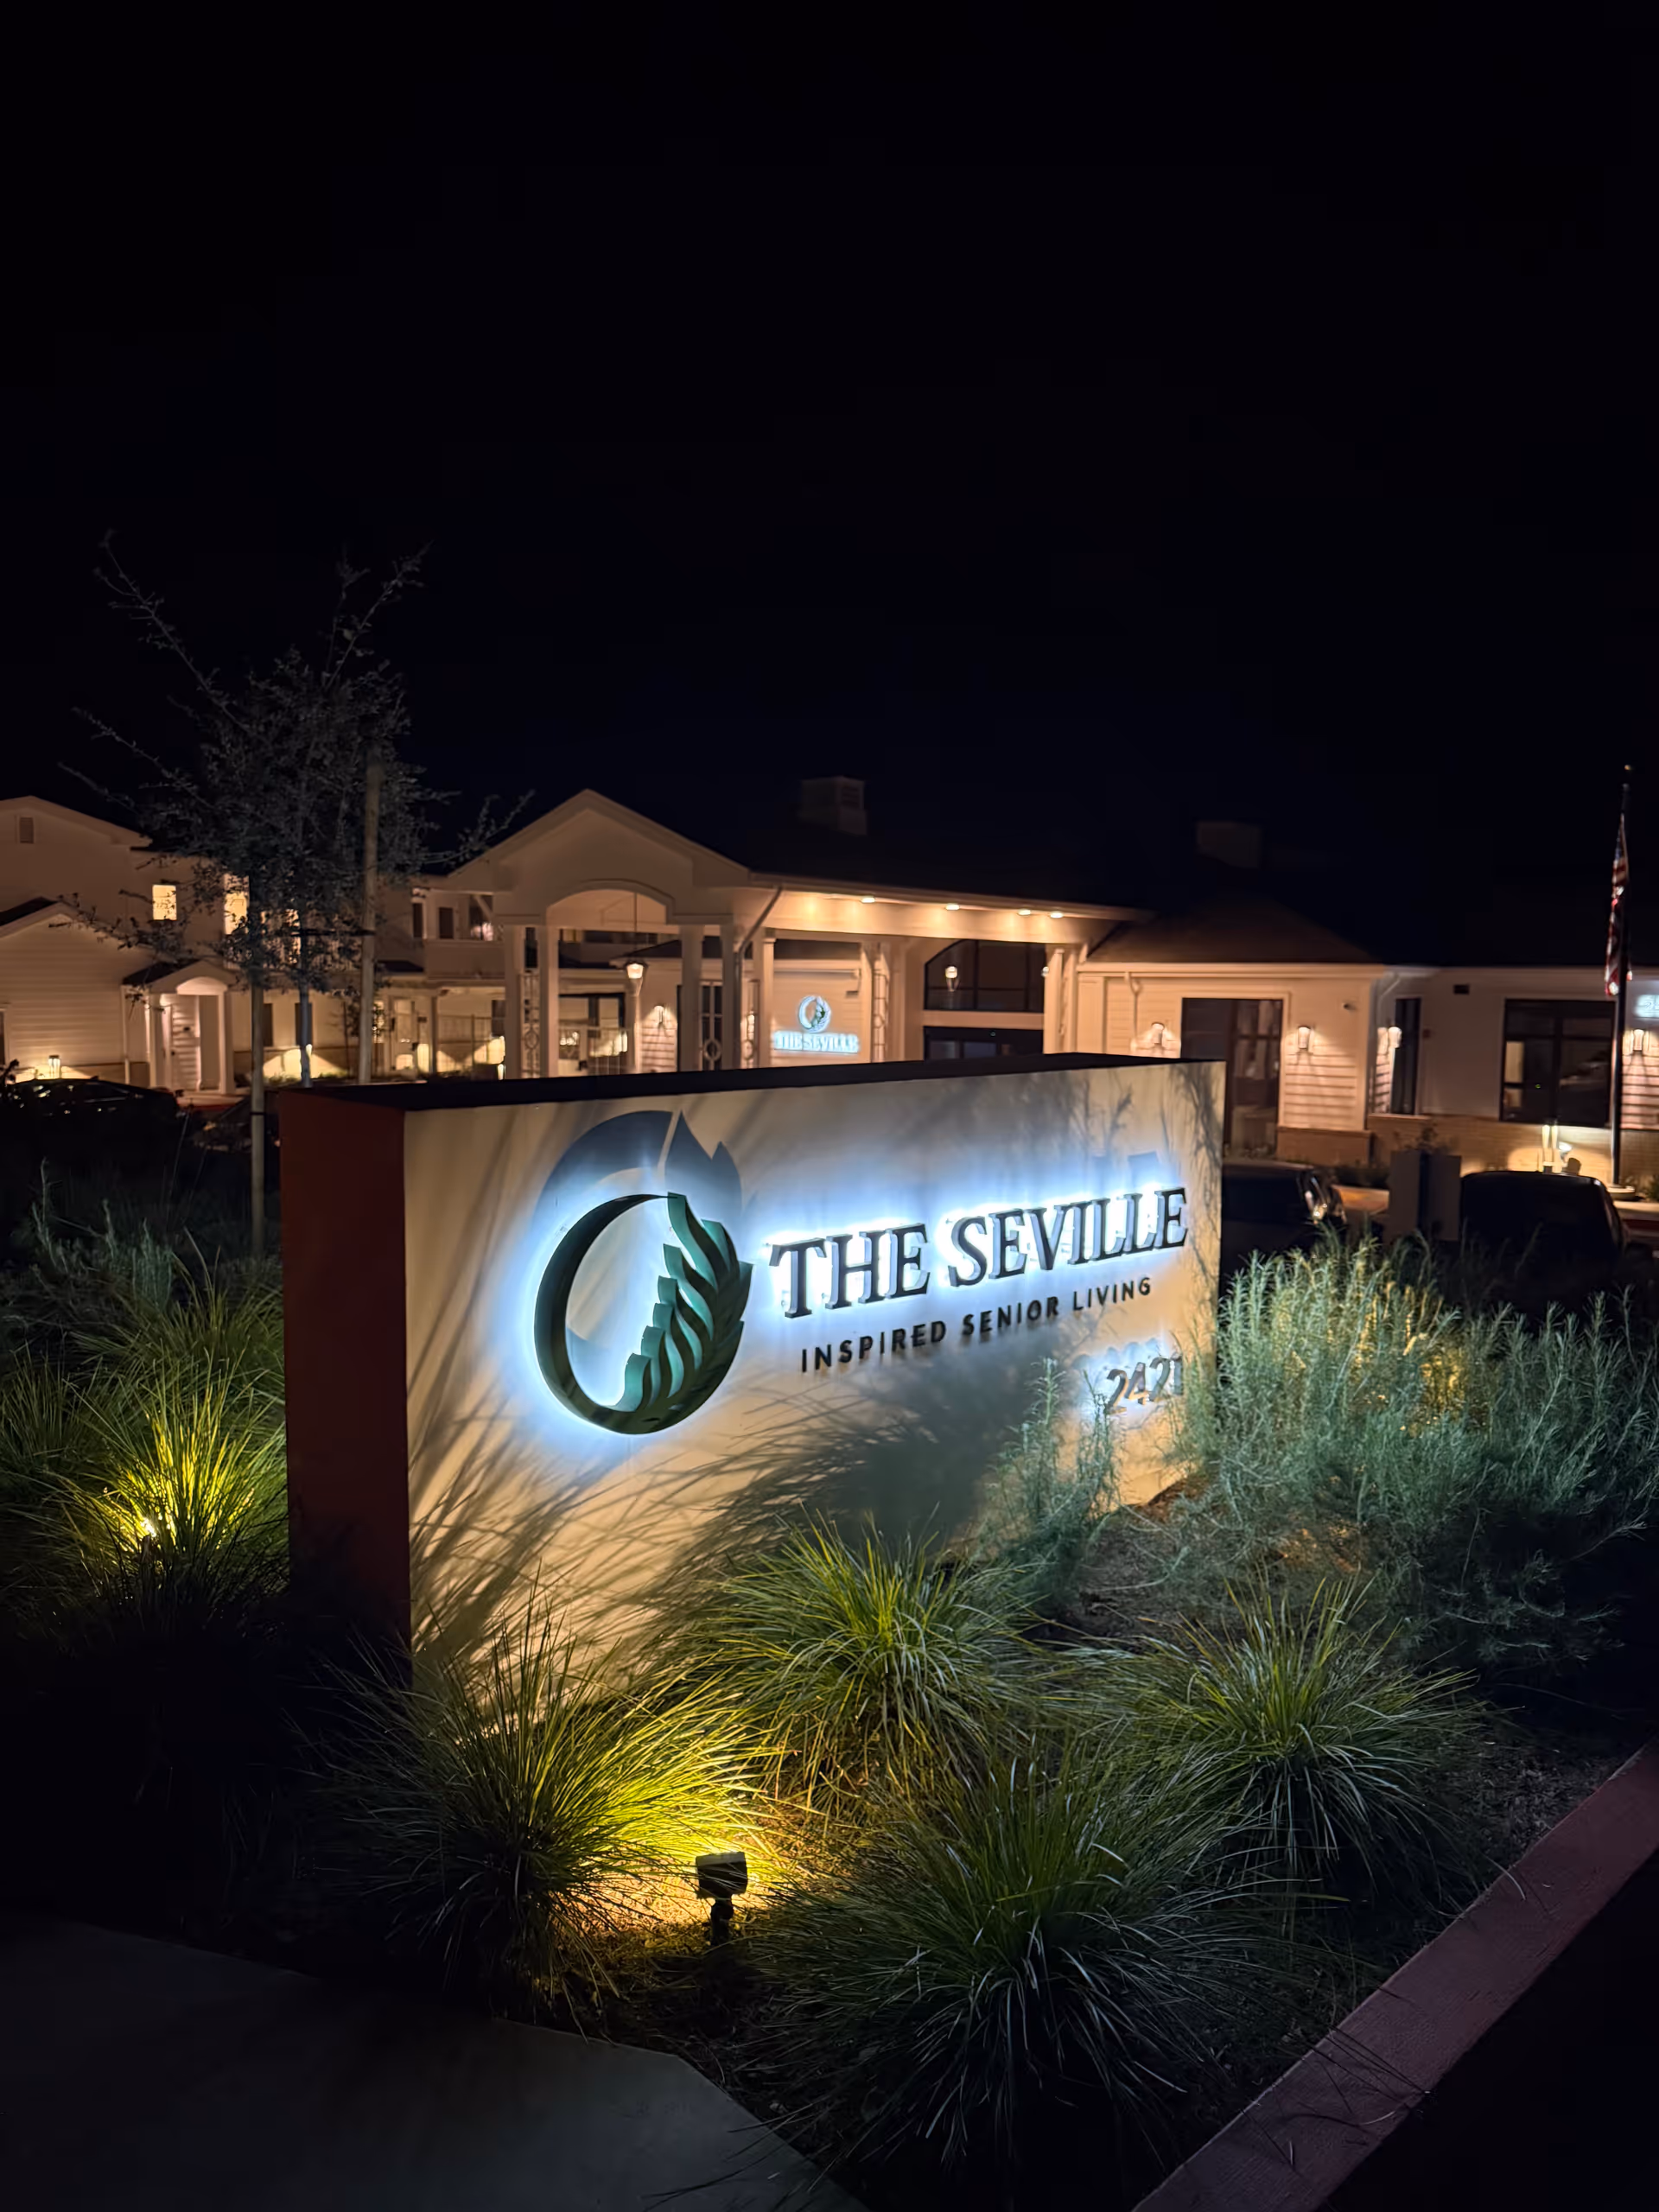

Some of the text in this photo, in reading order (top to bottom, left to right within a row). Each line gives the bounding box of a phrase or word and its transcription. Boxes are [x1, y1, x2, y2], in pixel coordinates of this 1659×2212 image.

[768, 1187, 1188, 1318] THE SEVILLE
[801, 1276, 1152, 1372] INSPIRED SENIOR LIVING
[1105, 1356, 1184, 1414] 2421
